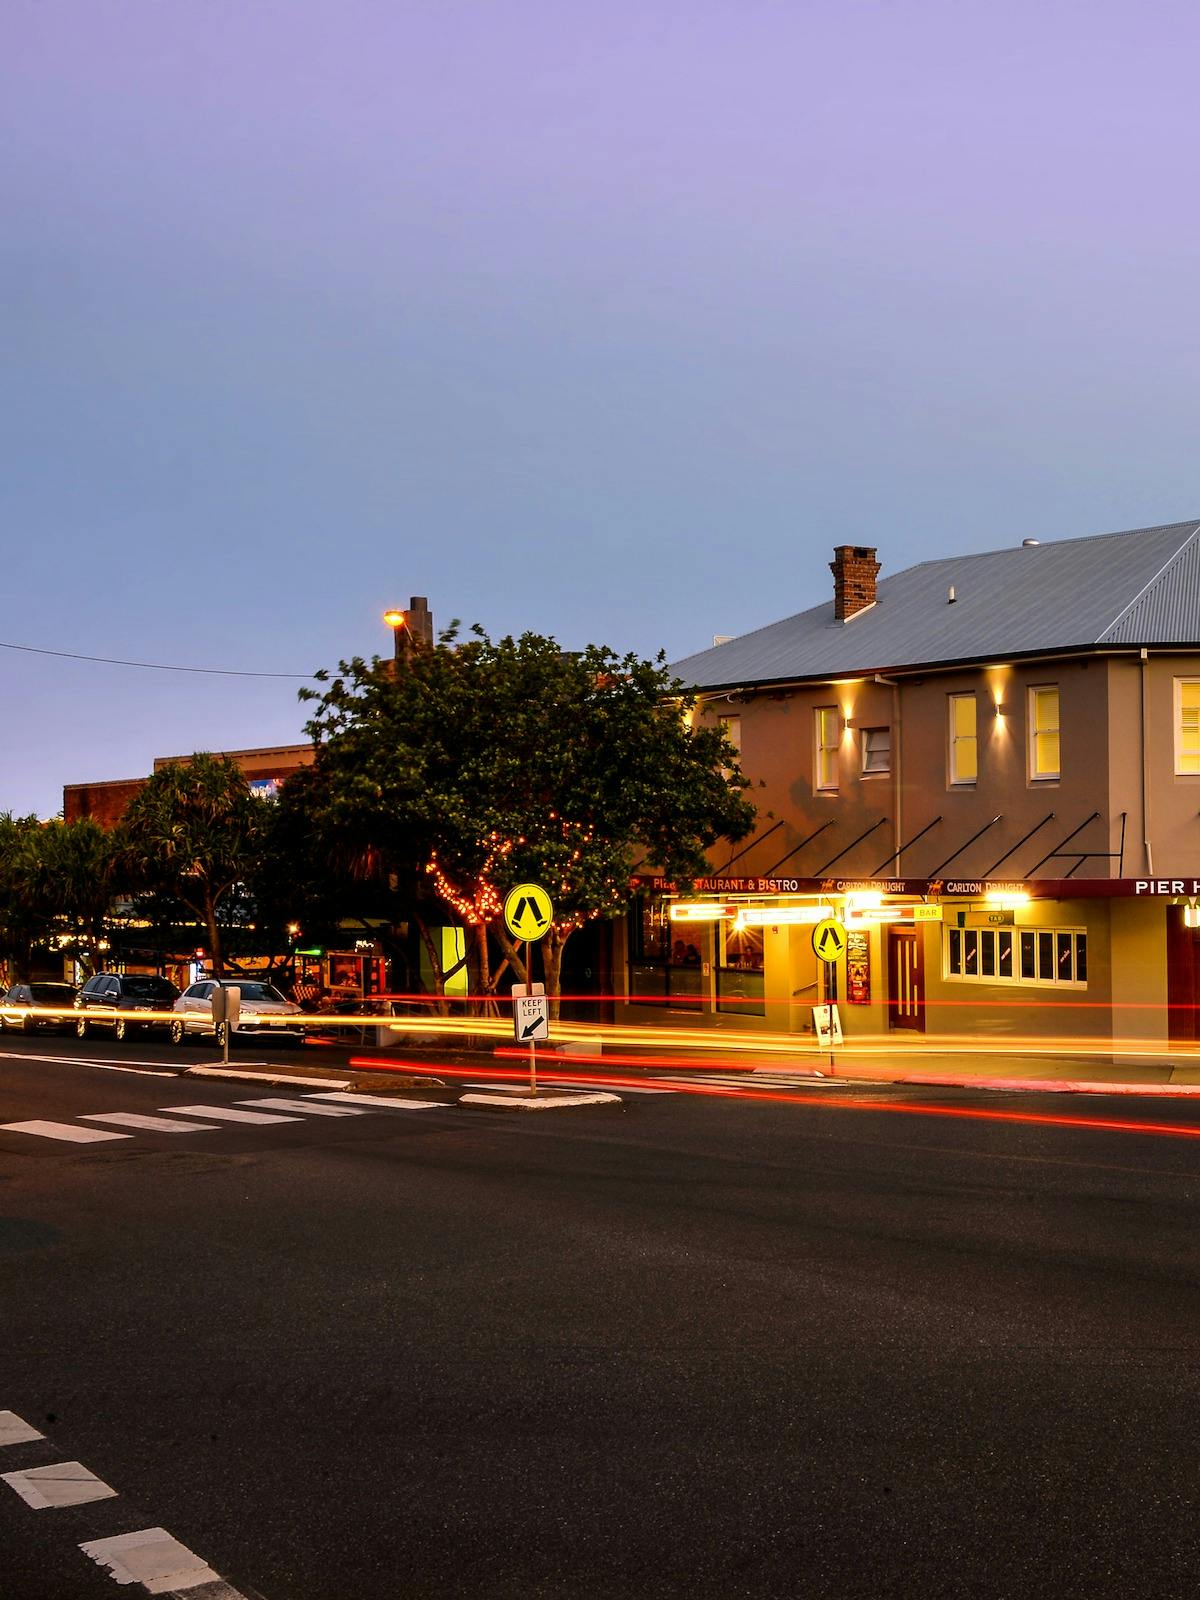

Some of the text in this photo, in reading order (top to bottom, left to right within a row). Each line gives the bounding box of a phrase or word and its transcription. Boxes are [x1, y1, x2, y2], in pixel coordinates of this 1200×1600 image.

[748, 879, 755, 890] &
[758, 879, 799, 891] BISTRO
[836, 881, 905, 892] CARLTON DRAUGHT
[946, 882, 1025, 893] CARLTON DRAUGHT
[1135, 881, 1185, 894] PIER
[919, 909, 937, 917] BAR
[522, 999, 542, 1007] KEEP
[523, 1008, 541, 1016] LEFT
